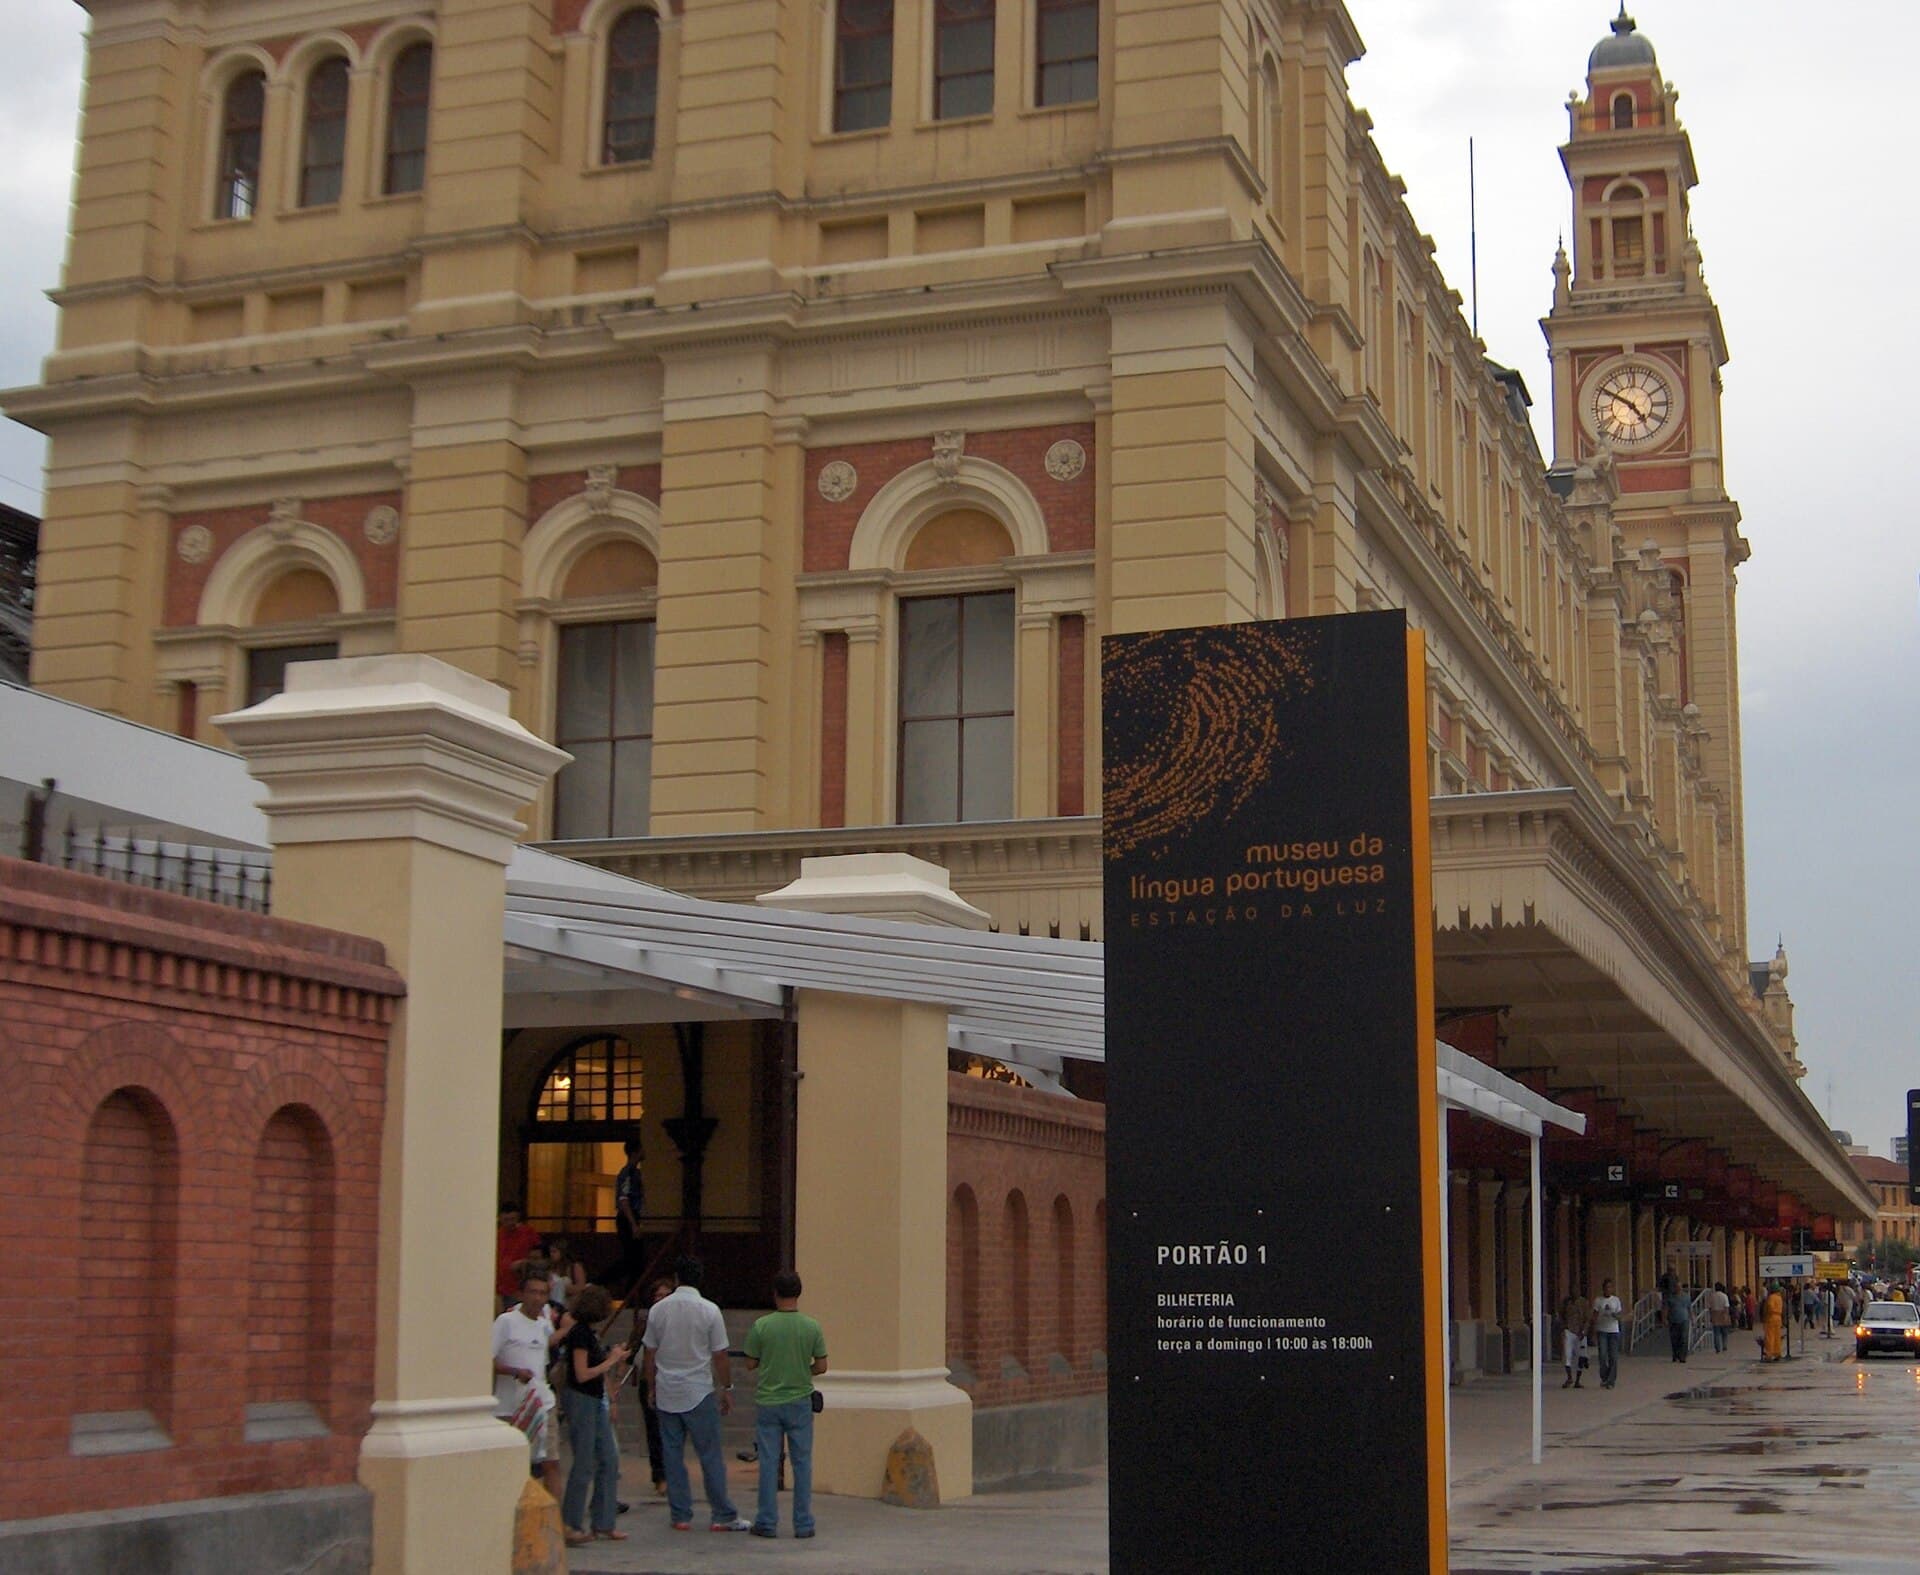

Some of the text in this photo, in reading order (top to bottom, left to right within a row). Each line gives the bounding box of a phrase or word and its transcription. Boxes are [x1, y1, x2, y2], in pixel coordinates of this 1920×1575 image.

[1246, 833, 1384, 863] museu da
[1131, 864, 1385, 903] língua portuguesa
[1281, 904, 1313, 917] DA
[1336, 899, 1386, 914] LUZ
[1157, 1240, 1266, 1265] PORTÃO 1
[1157, 1293, 1235, 1307] BILHETERIA
[1157, 1315, 1326, 1329] horário de funcionamento
[1157, 1339, 1191, 1354] terça
[1195, 1340, 1203, 1350] a
[1207, 1337, 1263, 1353] domingo
[1275, 1337, 1308, 1350] 10:00
[1311, 1336, 1327, 1350] às
[1331, 1337, 1373, 1350] 18:00h
